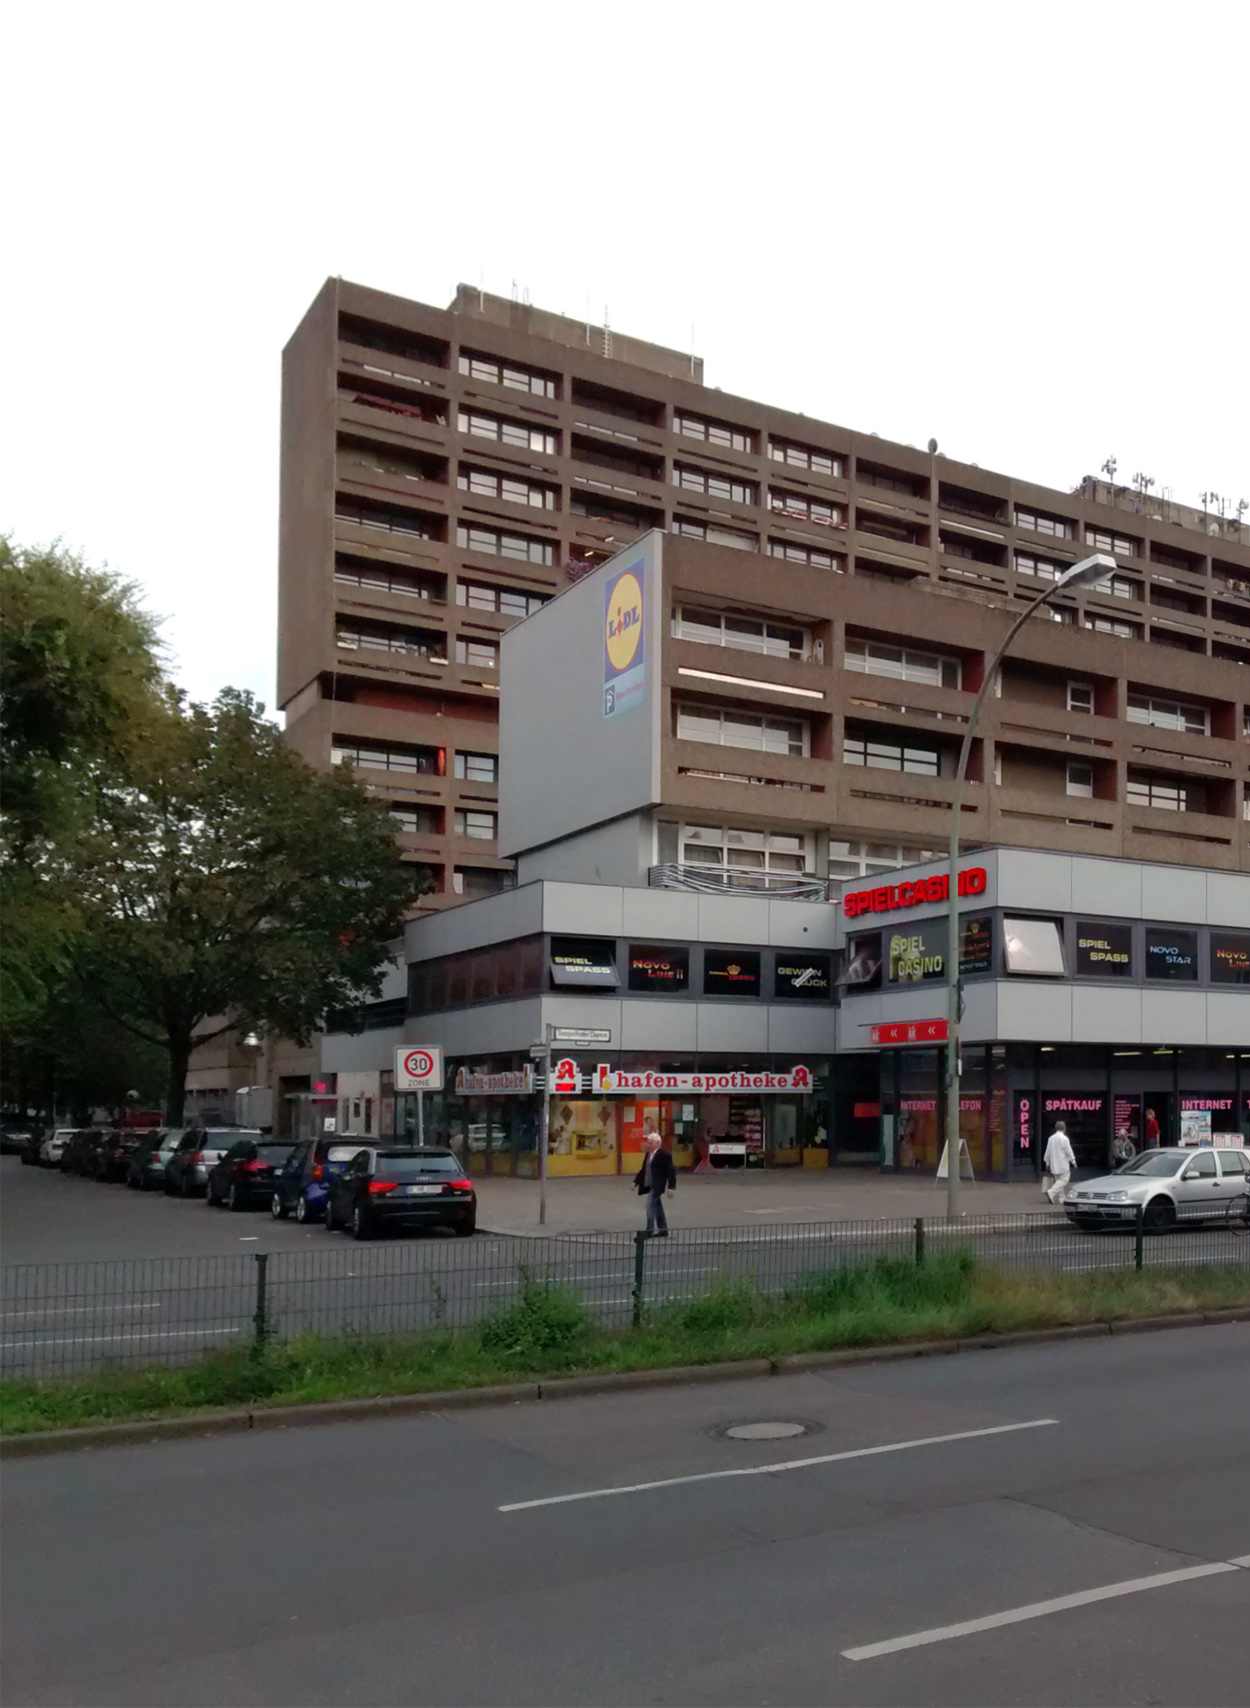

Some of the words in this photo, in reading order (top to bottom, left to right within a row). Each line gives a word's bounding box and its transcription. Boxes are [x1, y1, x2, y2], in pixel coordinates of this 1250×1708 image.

[890, 936, 925, 955] SPIEL
[1078, 938, 1111, 950] SPIEL
[1150, 945, 1179, 955] NOVO
[554, 956, 593, 965] SPIEL
[1089, 951, 1129, 963] SPASS
[1165, 955, 1191, 965] STAR
[565, 965, 611, 974] SPASS
[898, 955, 942, 976] CASINO
[410, 1058, 427, 1071] 30
[616, 1072, 788, 1091] hafen-apotheke
[900, 1100, 937, 1111] INTERNET
[958, 1100, 982, 1111] LEFON
[1045, 1098, 1102, 1111] SPÄTKAUF
[1182, 1099, 1233, 1110] INTERNET
[1020, 1099, 1030, 1148] OPEN
